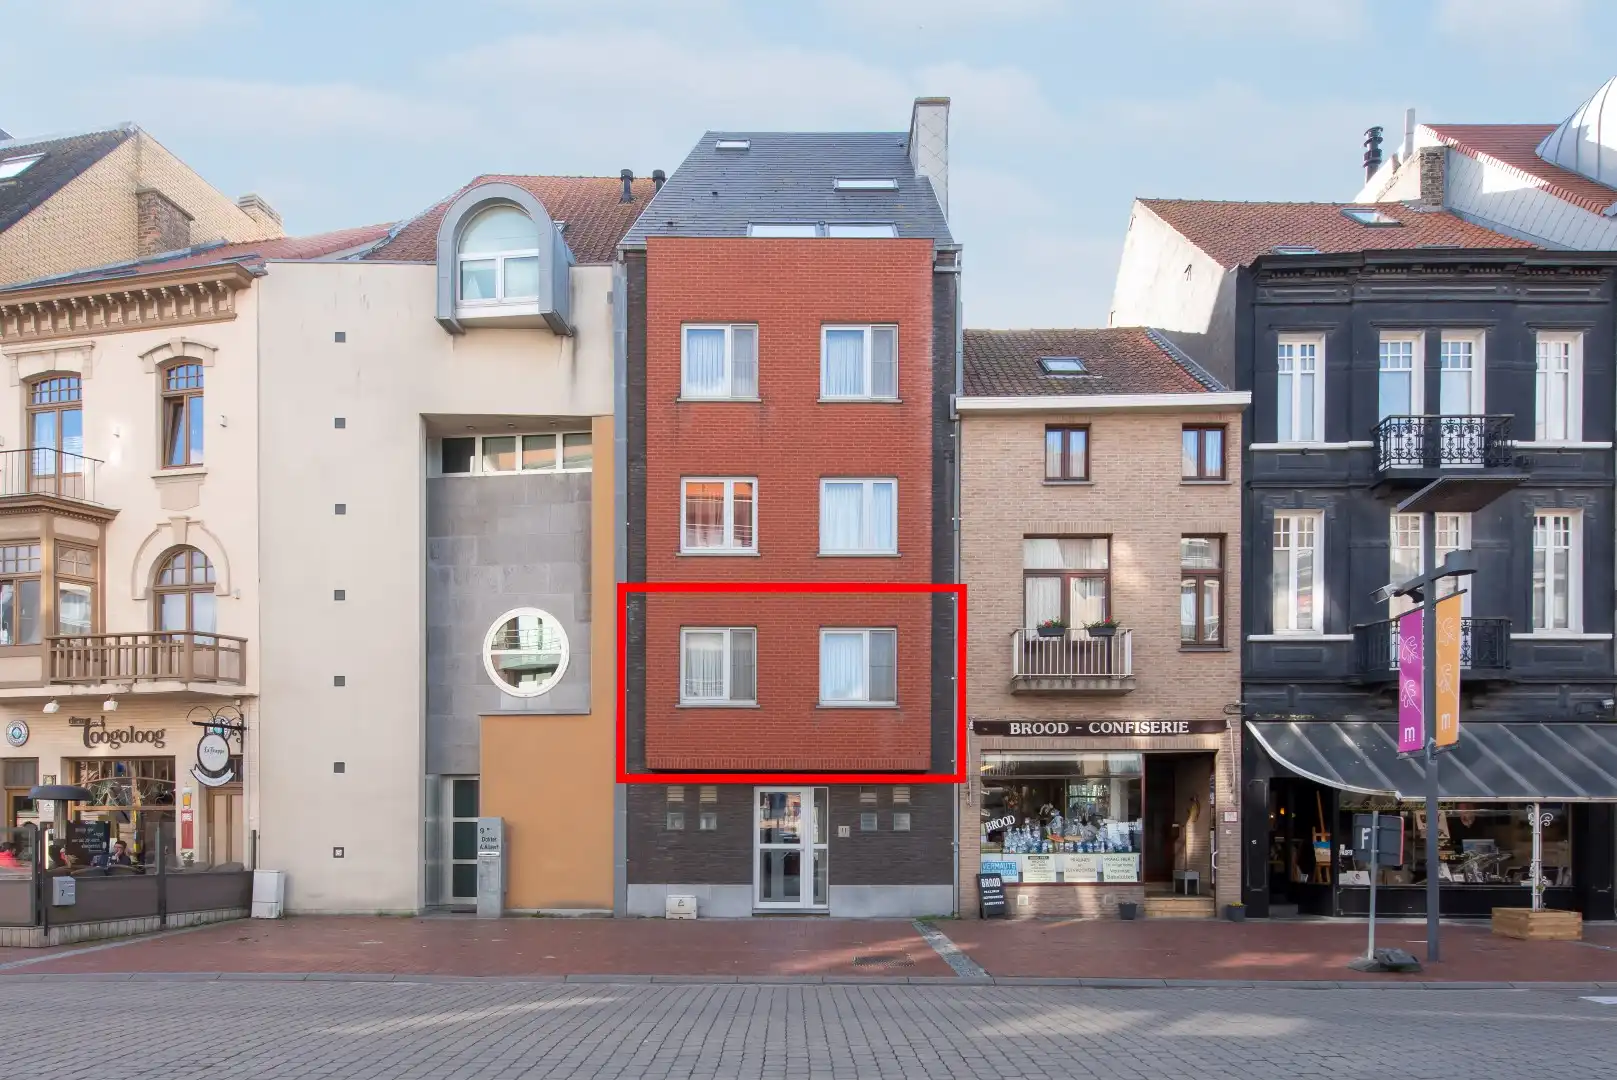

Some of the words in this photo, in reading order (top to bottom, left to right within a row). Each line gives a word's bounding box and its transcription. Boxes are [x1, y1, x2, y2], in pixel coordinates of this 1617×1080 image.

[1010, 722, 1069, 735] BROOD
[1088, 721, 1190, 734] CONFISERIE
[984, 815, 1016, 832] BROOD
[980, 878, 1001, 888] BROOD
